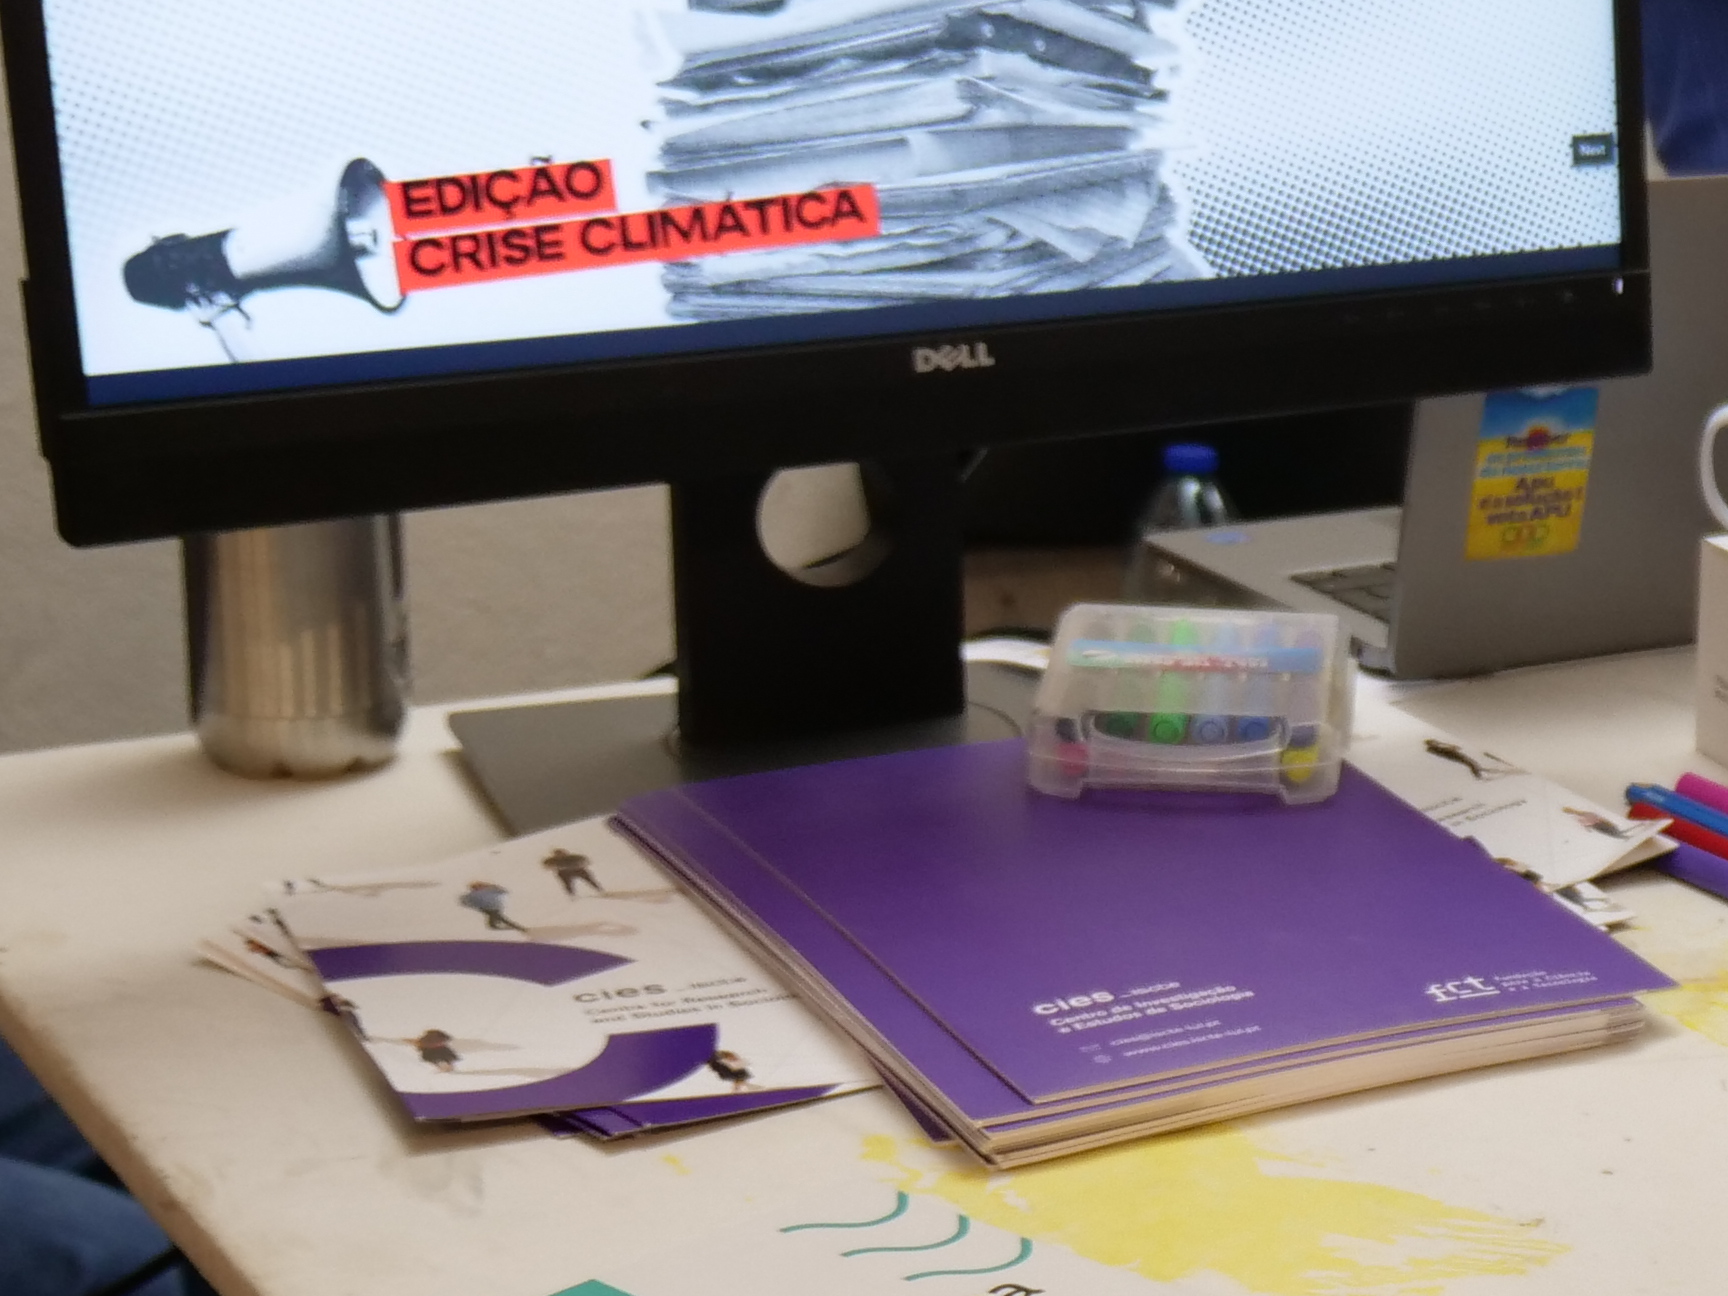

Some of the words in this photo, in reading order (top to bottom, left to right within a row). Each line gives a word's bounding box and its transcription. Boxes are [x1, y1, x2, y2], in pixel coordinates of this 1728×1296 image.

[401, 155, 606, 223] EDIÇÃO
[408, 233, 565, 279] CRISE
[580, 188, 866, 258] CLIMÁTICA
[912, 341, 996, 373] DELL
[572, 984, 668, 1003] cies
[1033, 990, 1116, 1016] cies
[1425, 976, 1501, 1002] fct
